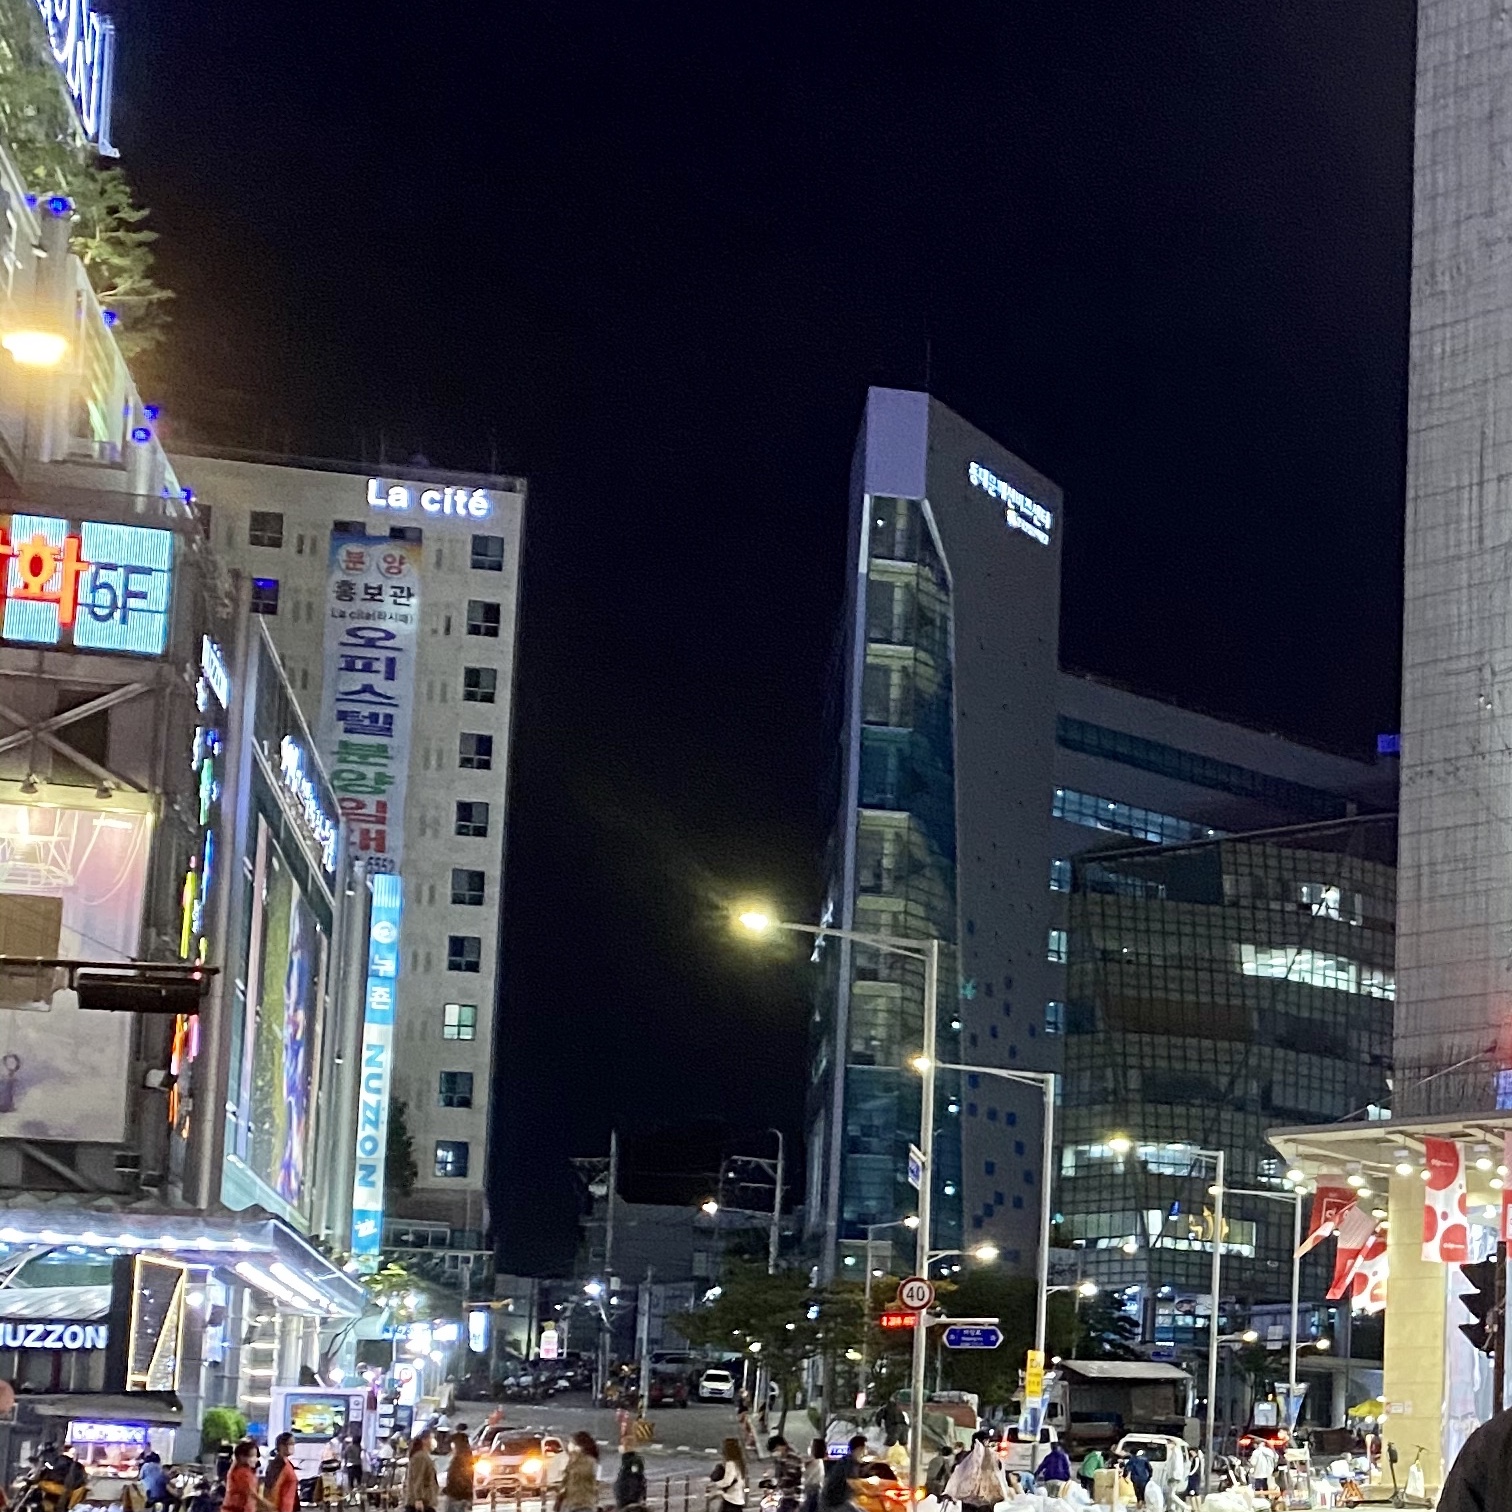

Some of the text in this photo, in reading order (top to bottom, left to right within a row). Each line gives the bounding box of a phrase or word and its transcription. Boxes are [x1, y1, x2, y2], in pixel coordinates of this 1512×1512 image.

[367, 478, 490, 516] La cité
[0, 532, 153, 626] 화 5F
[358, 1043, 386, 1188] NUZZON
[906, 1285, 925, 1302] 40
[0, 1322, 108, 1350] UZZON
